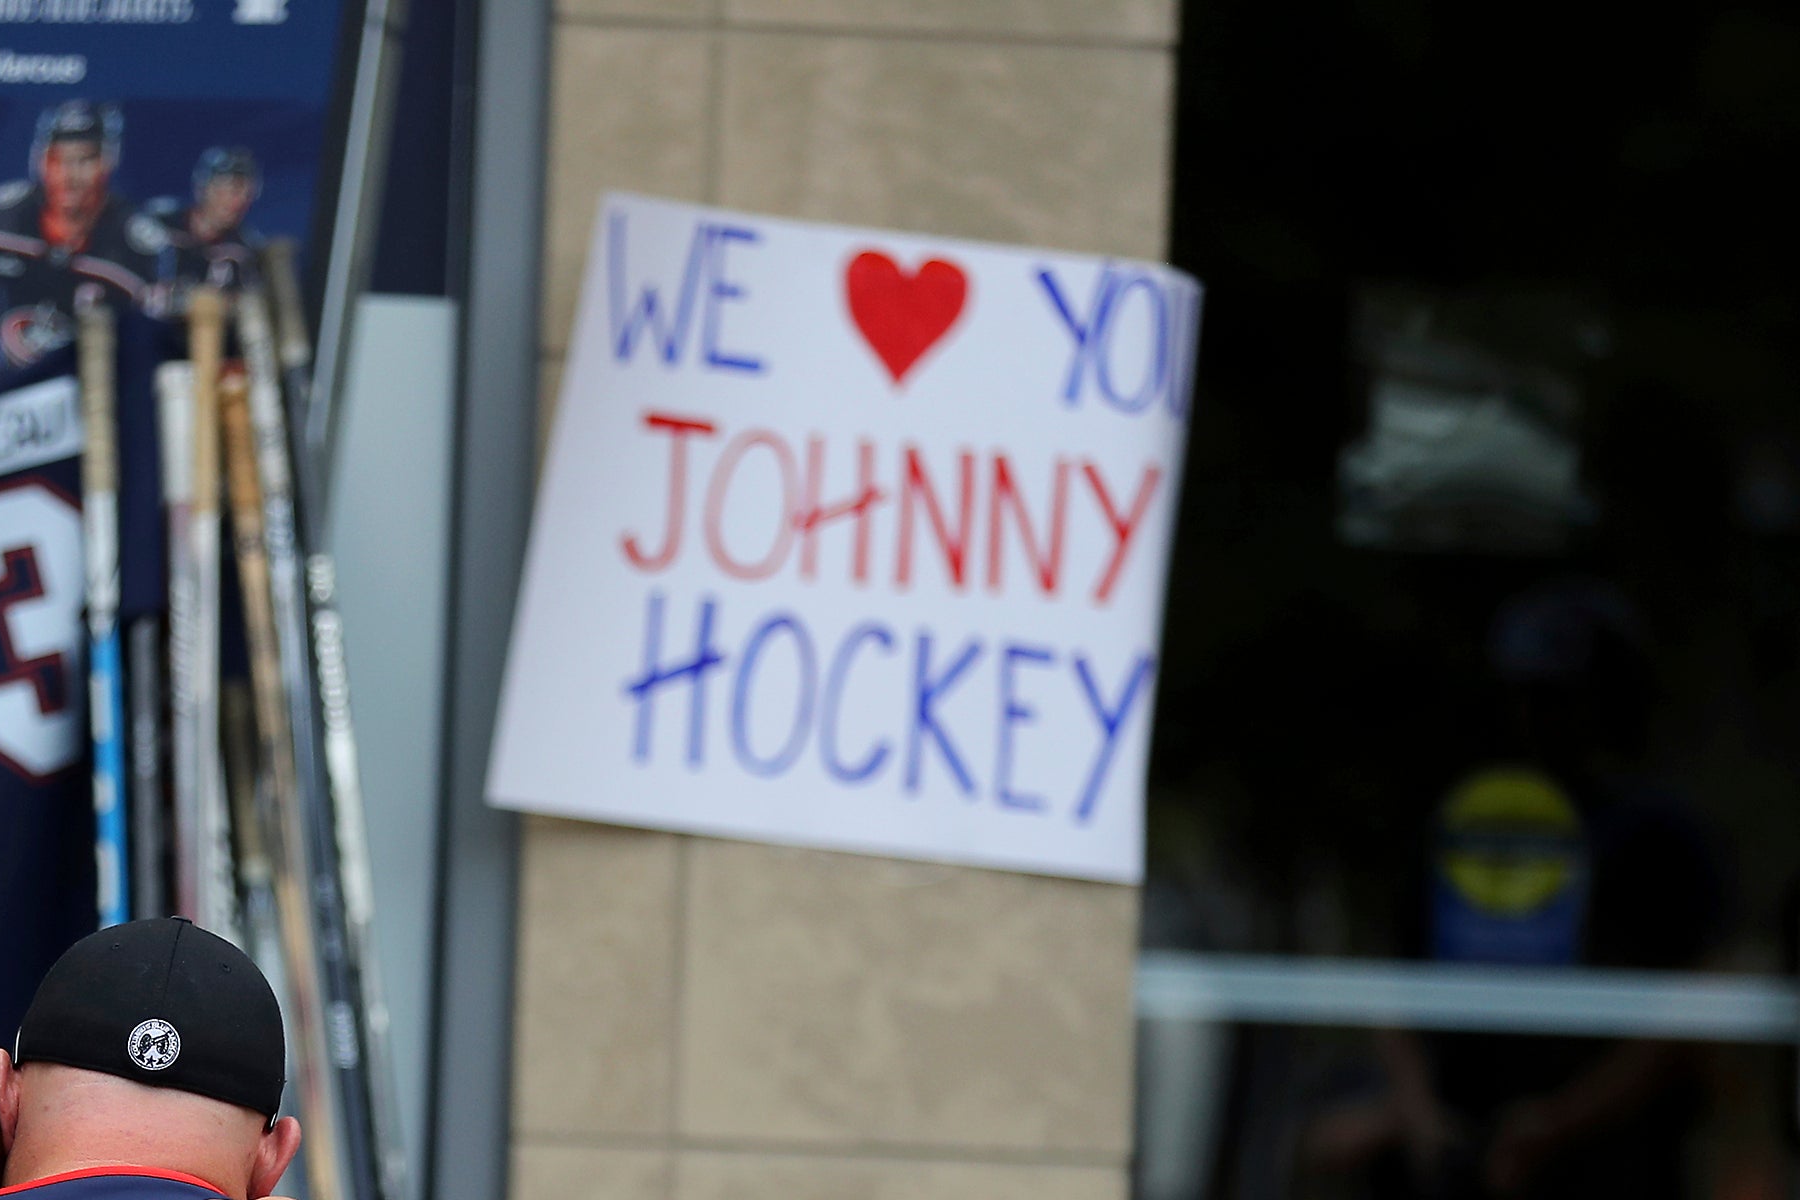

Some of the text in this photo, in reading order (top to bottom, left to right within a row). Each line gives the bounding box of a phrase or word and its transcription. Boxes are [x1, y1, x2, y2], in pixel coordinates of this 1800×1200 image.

[606, 209, 770, 374] WE
[619, 409, 1161, 607] JOHNNY
[626, 592, 1155, 825] HOCKEY
